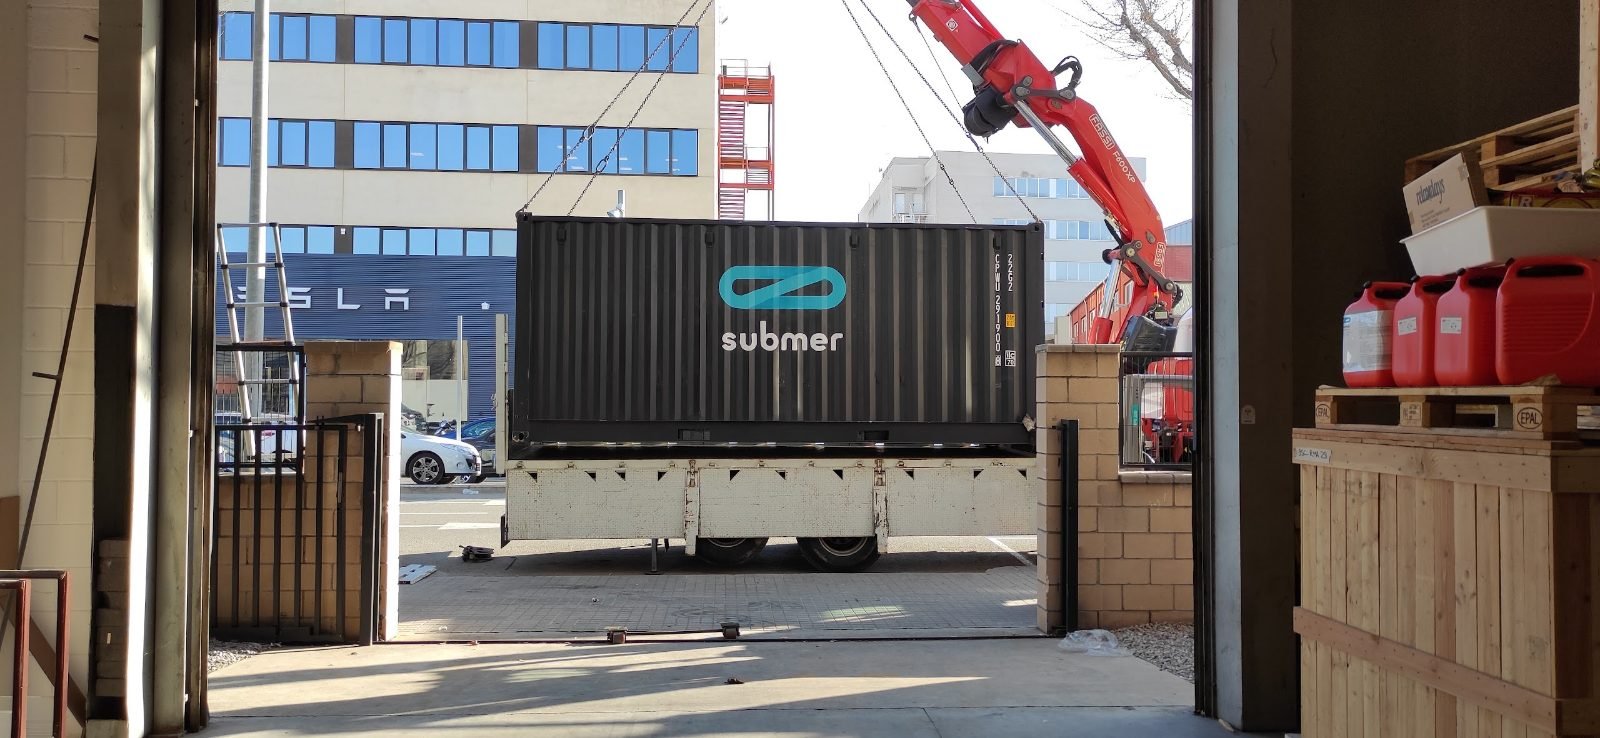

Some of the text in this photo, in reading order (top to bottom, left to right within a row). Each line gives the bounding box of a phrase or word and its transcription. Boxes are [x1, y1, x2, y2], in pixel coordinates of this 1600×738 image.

[1091, 117, 1136, 183] FASSI F600XP
[1416, 178, 1445, 206] relaxdays
[721, 320, 844, 352] submer
[1318, 407, 1329, 418] EPAL
[1520, 412, 1540, 424] EPAL
